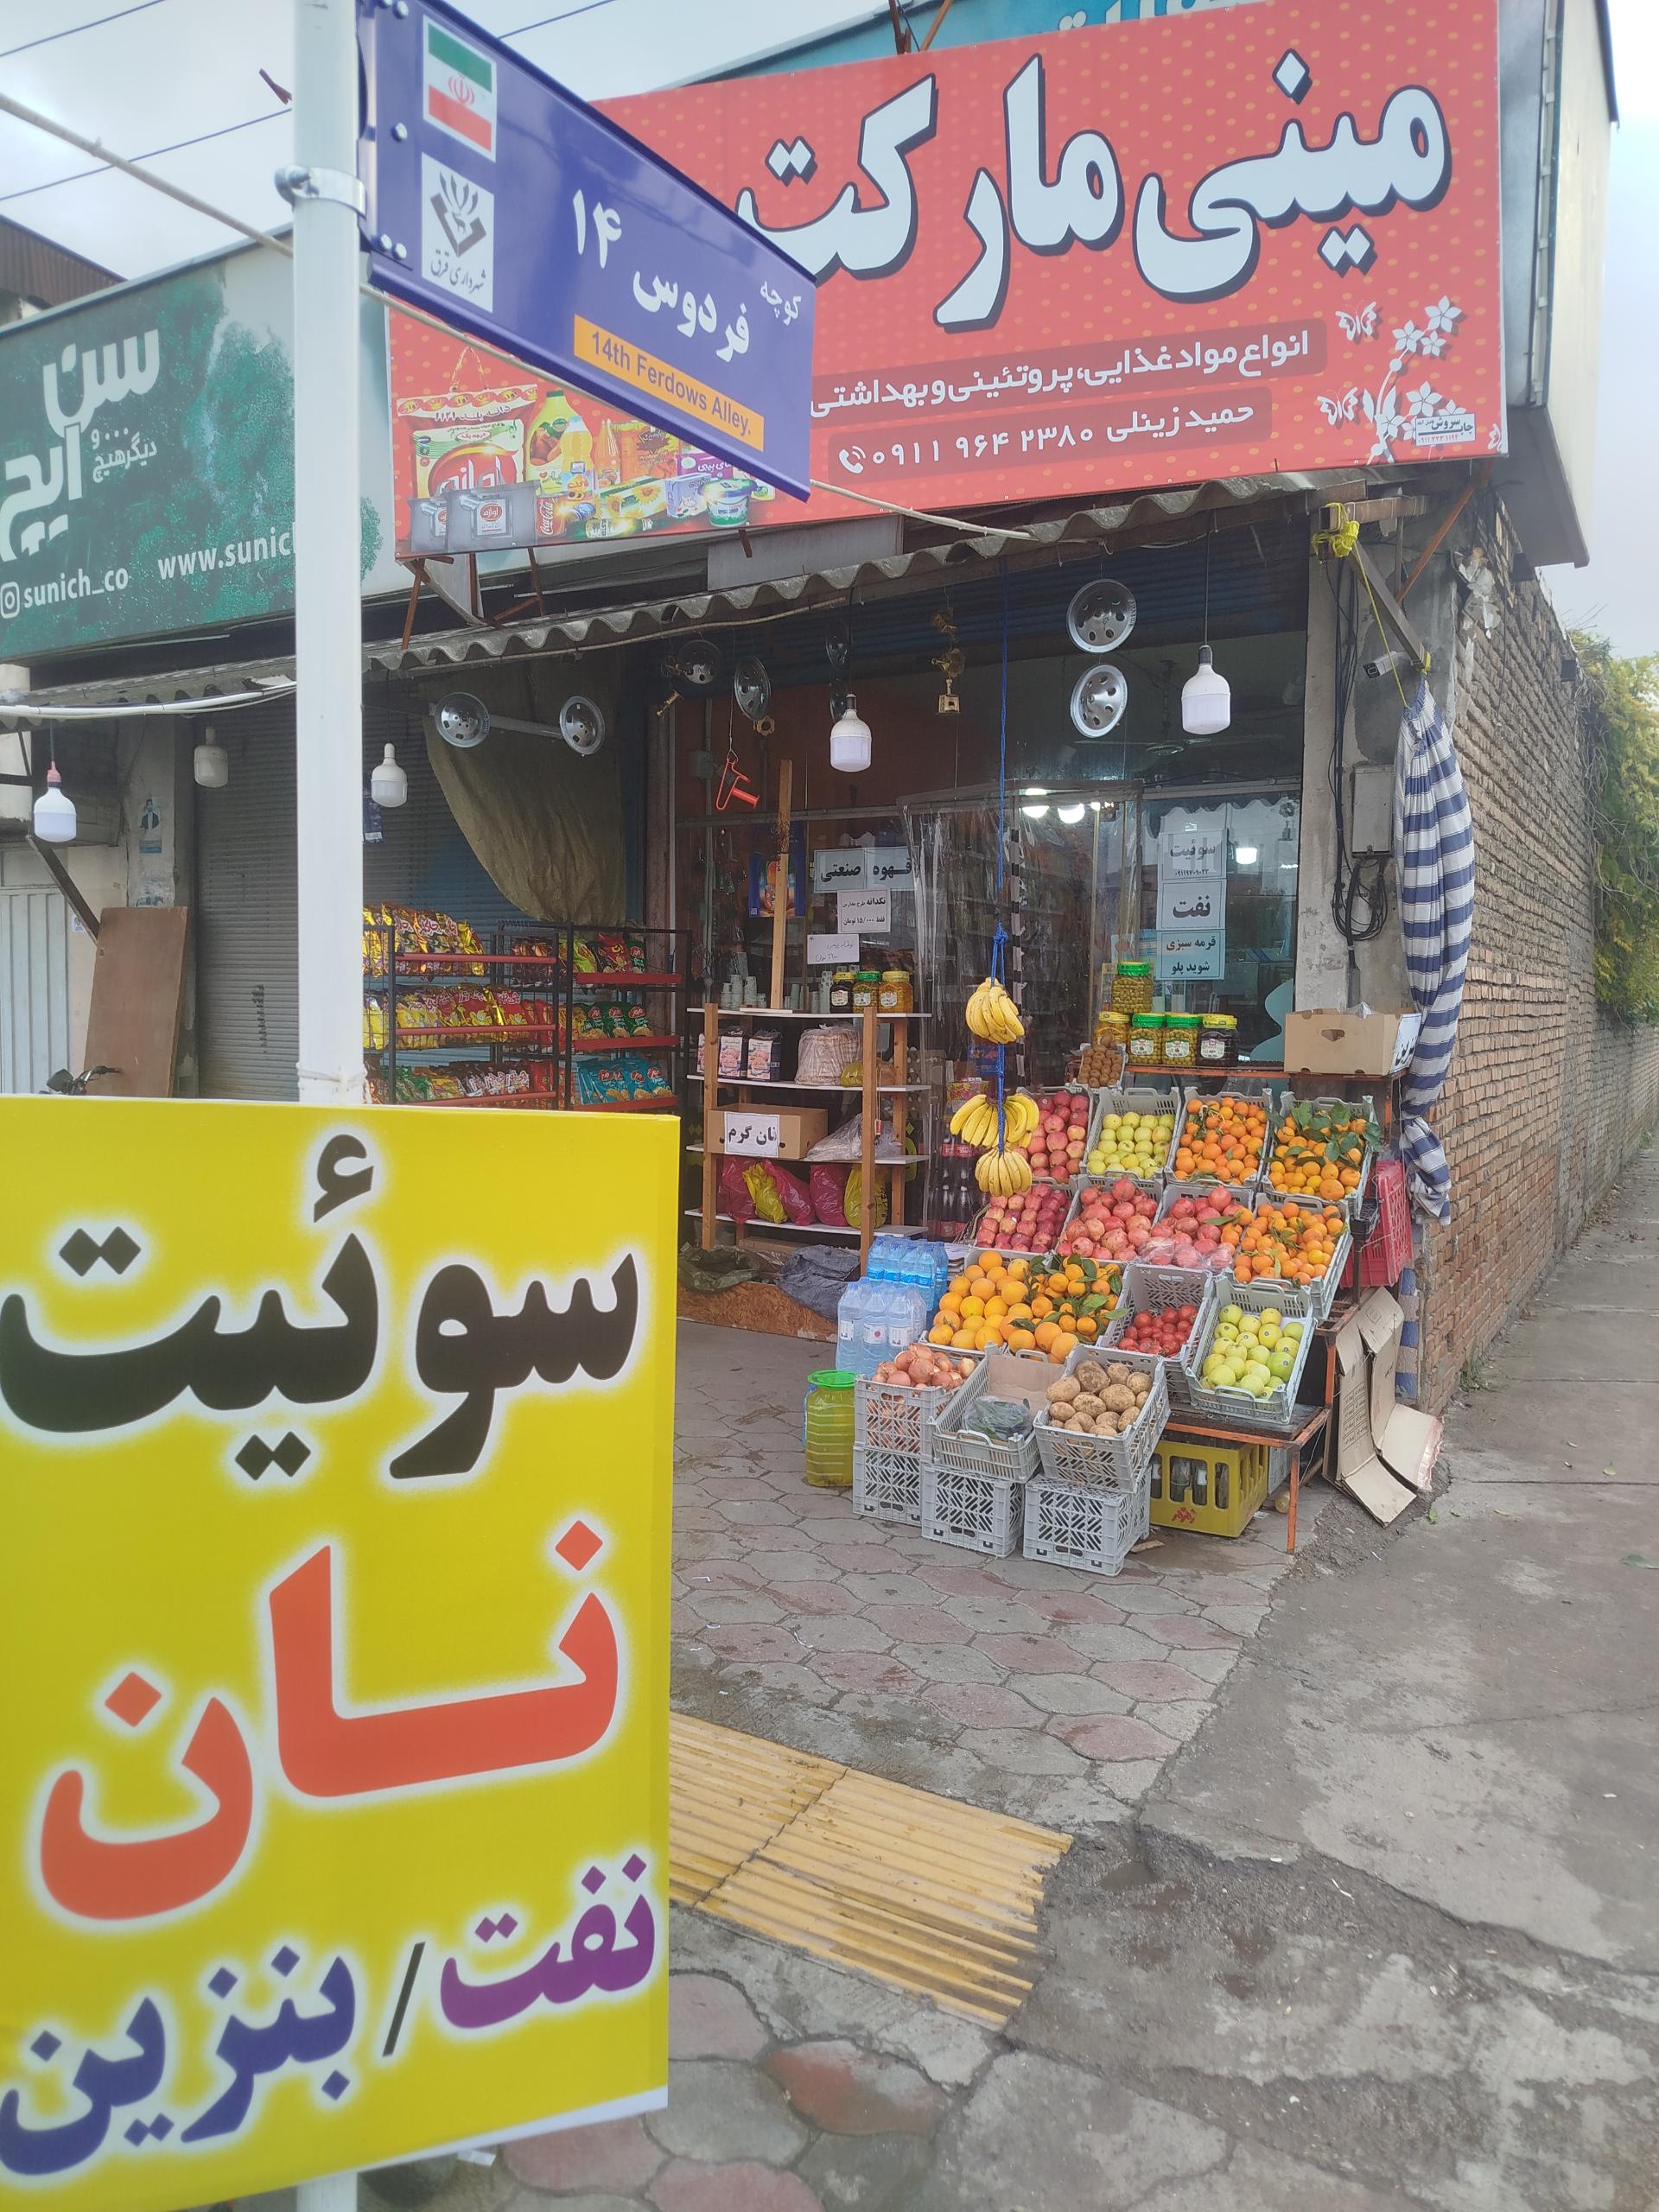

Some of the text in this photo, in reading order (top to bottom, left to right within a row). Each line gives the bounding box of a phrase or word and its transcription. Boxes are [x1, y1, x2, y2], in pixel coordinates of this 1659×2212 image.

[736, 48, 1452, 332] مینی مارکت
[449, 267, 486, 295] شهرداری
[572, 188, 802, 363] کوچه فردوس ۱۴
[1176, 341, 1237, 374] مواد
[1238, 330, 1308, 378] انواع
[591, 331, 752, 437] 14th Ferdows Alley.
[810, 379, 929, 418] بهداشتی
[873, 404, 1254, 466] حمید زینلی ۰۹۱۱ ۹۶۴ ۲۳۸۰
[157, 522, 296, 581] www.sunic
[23, 567, 129, 608] sunich_co
[821, 858, 912, 882] قهوه صنعتی
[1173, 895, 1211, 918] نفت
[1166, 936, 1216, 950] قرمه سبزی
[1171, 961, 1210, 975] شوید پلو
[728, 1125, 777, 1145] نان گرم
[0, 1134, 639, 1481] سوئیت
[40, 1520, 620, 1921] نان
